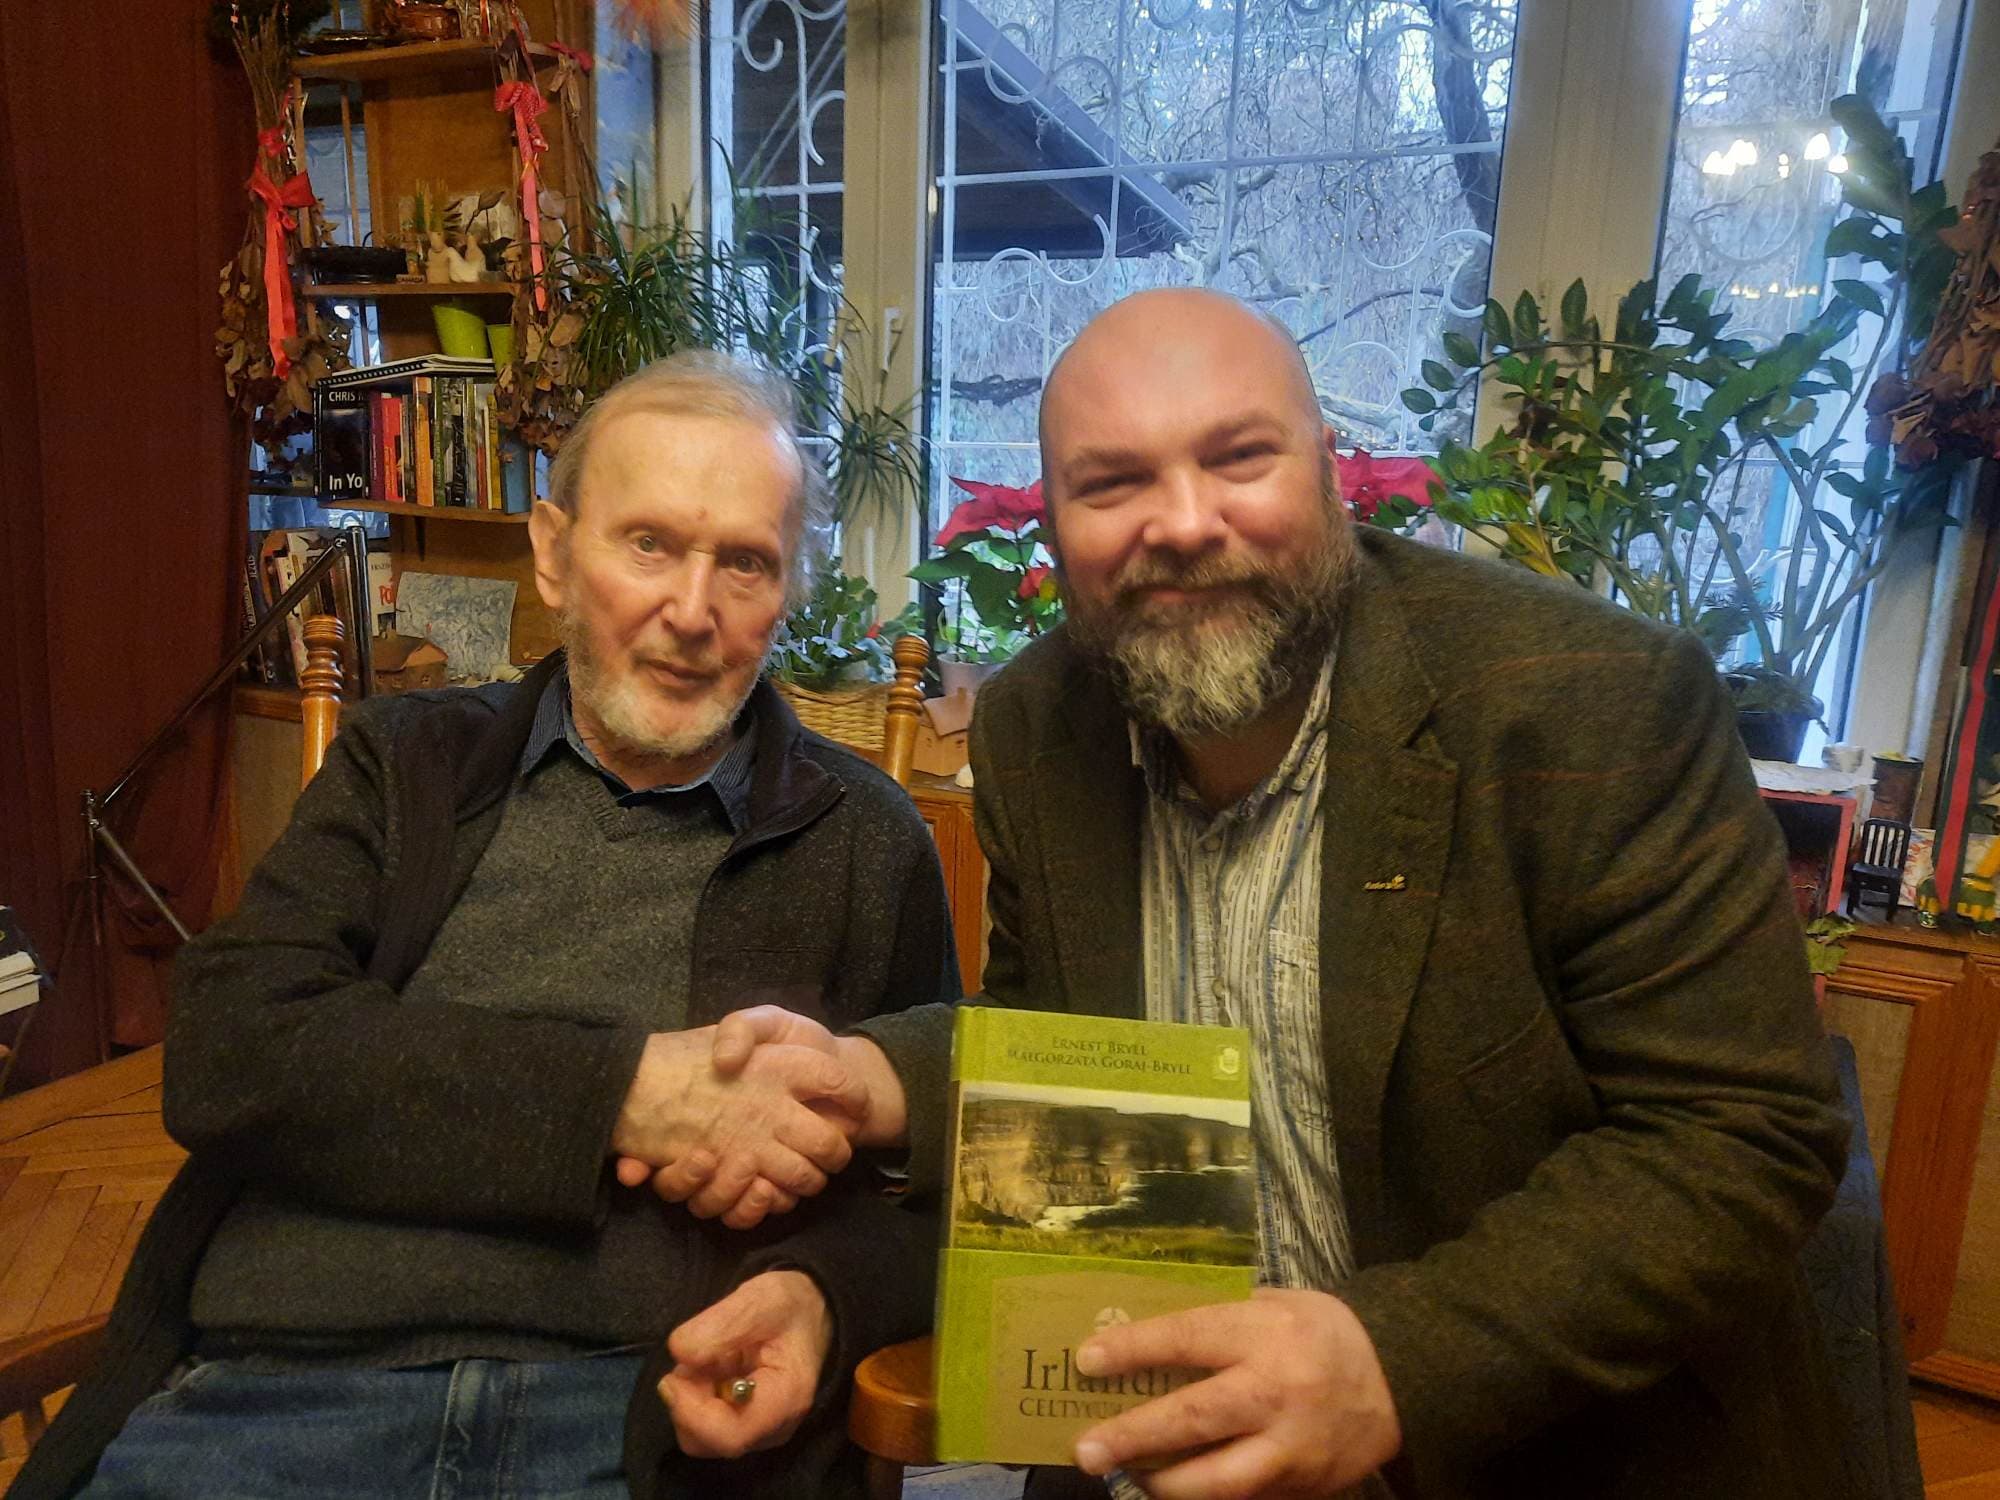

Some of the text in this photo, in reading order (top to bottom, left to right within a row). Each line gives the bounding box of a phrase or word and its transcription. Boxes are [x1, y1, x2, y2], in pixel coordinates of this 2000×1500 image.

[328, 391, 356, 402] CHRIS
[329, 473, 364, 491] In Yo
[1052, 1037, 1149, 1057] ERNEST BRYLL
[1021, 1346, 1172, 1397] Irlandi
